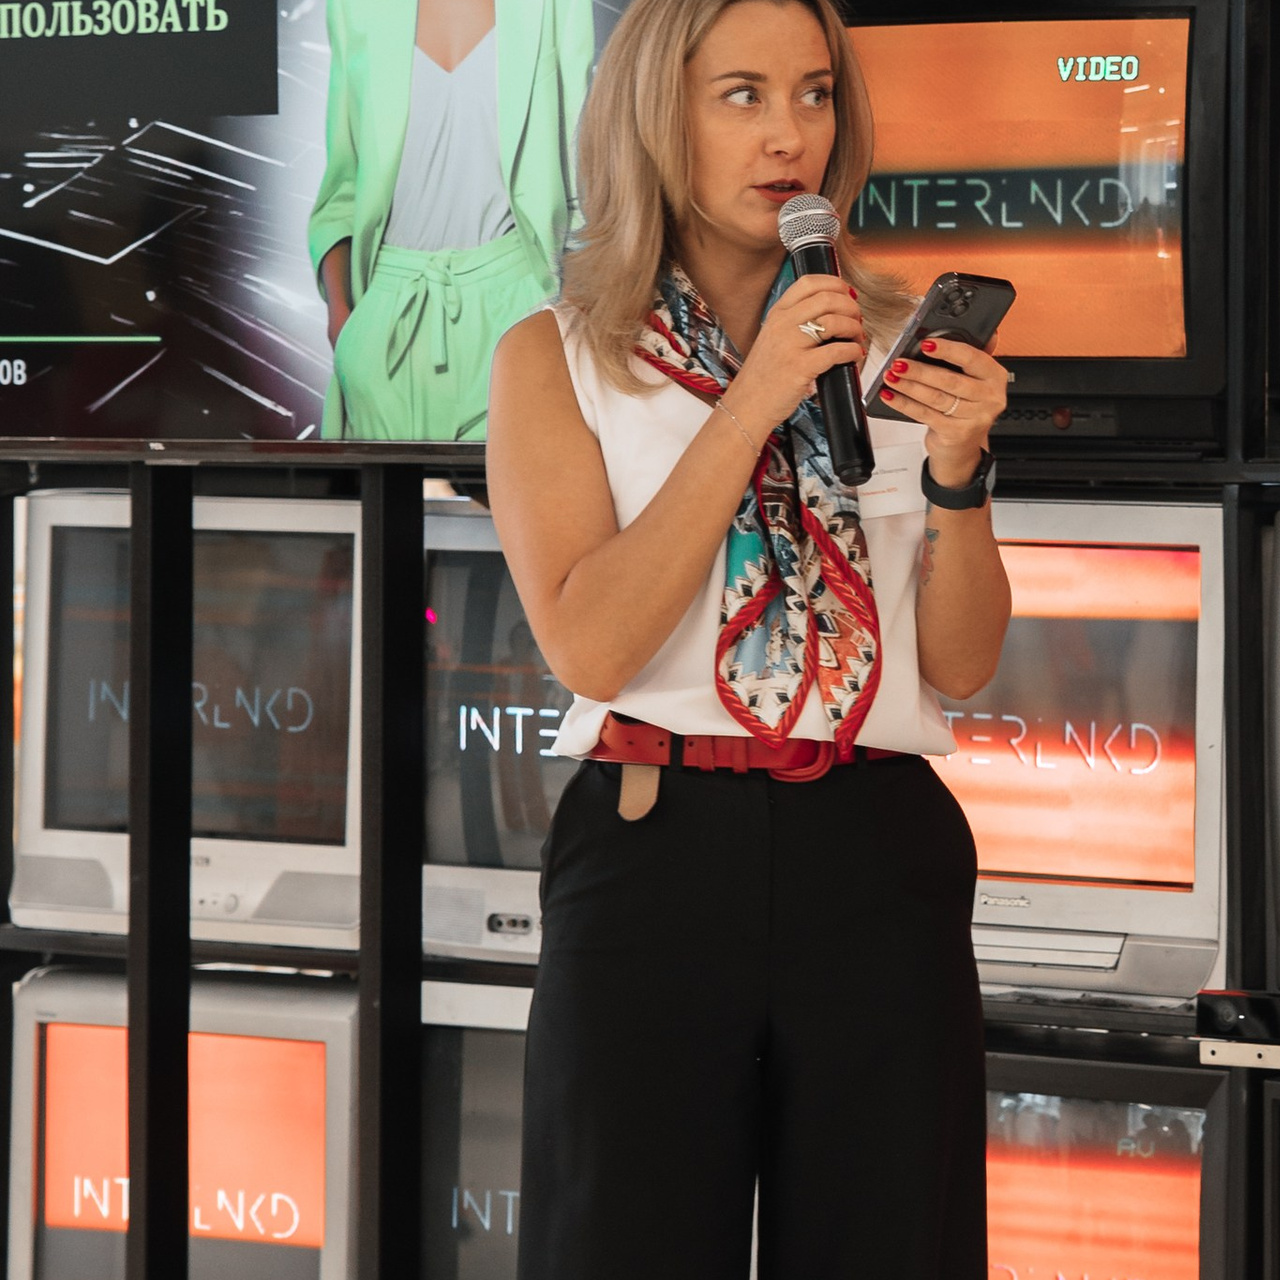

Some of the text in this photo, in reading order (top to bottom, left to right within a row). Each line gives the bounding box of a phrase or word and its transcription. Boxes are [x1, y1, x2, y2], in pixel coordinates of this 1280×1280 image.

[1057, 54, 1139, 82] VIDEO
[980, 894, 1031, 907] Panasonic
[1117, 1138, 1155, 1157] AV
[451, 1187, 520, 1235] INT
